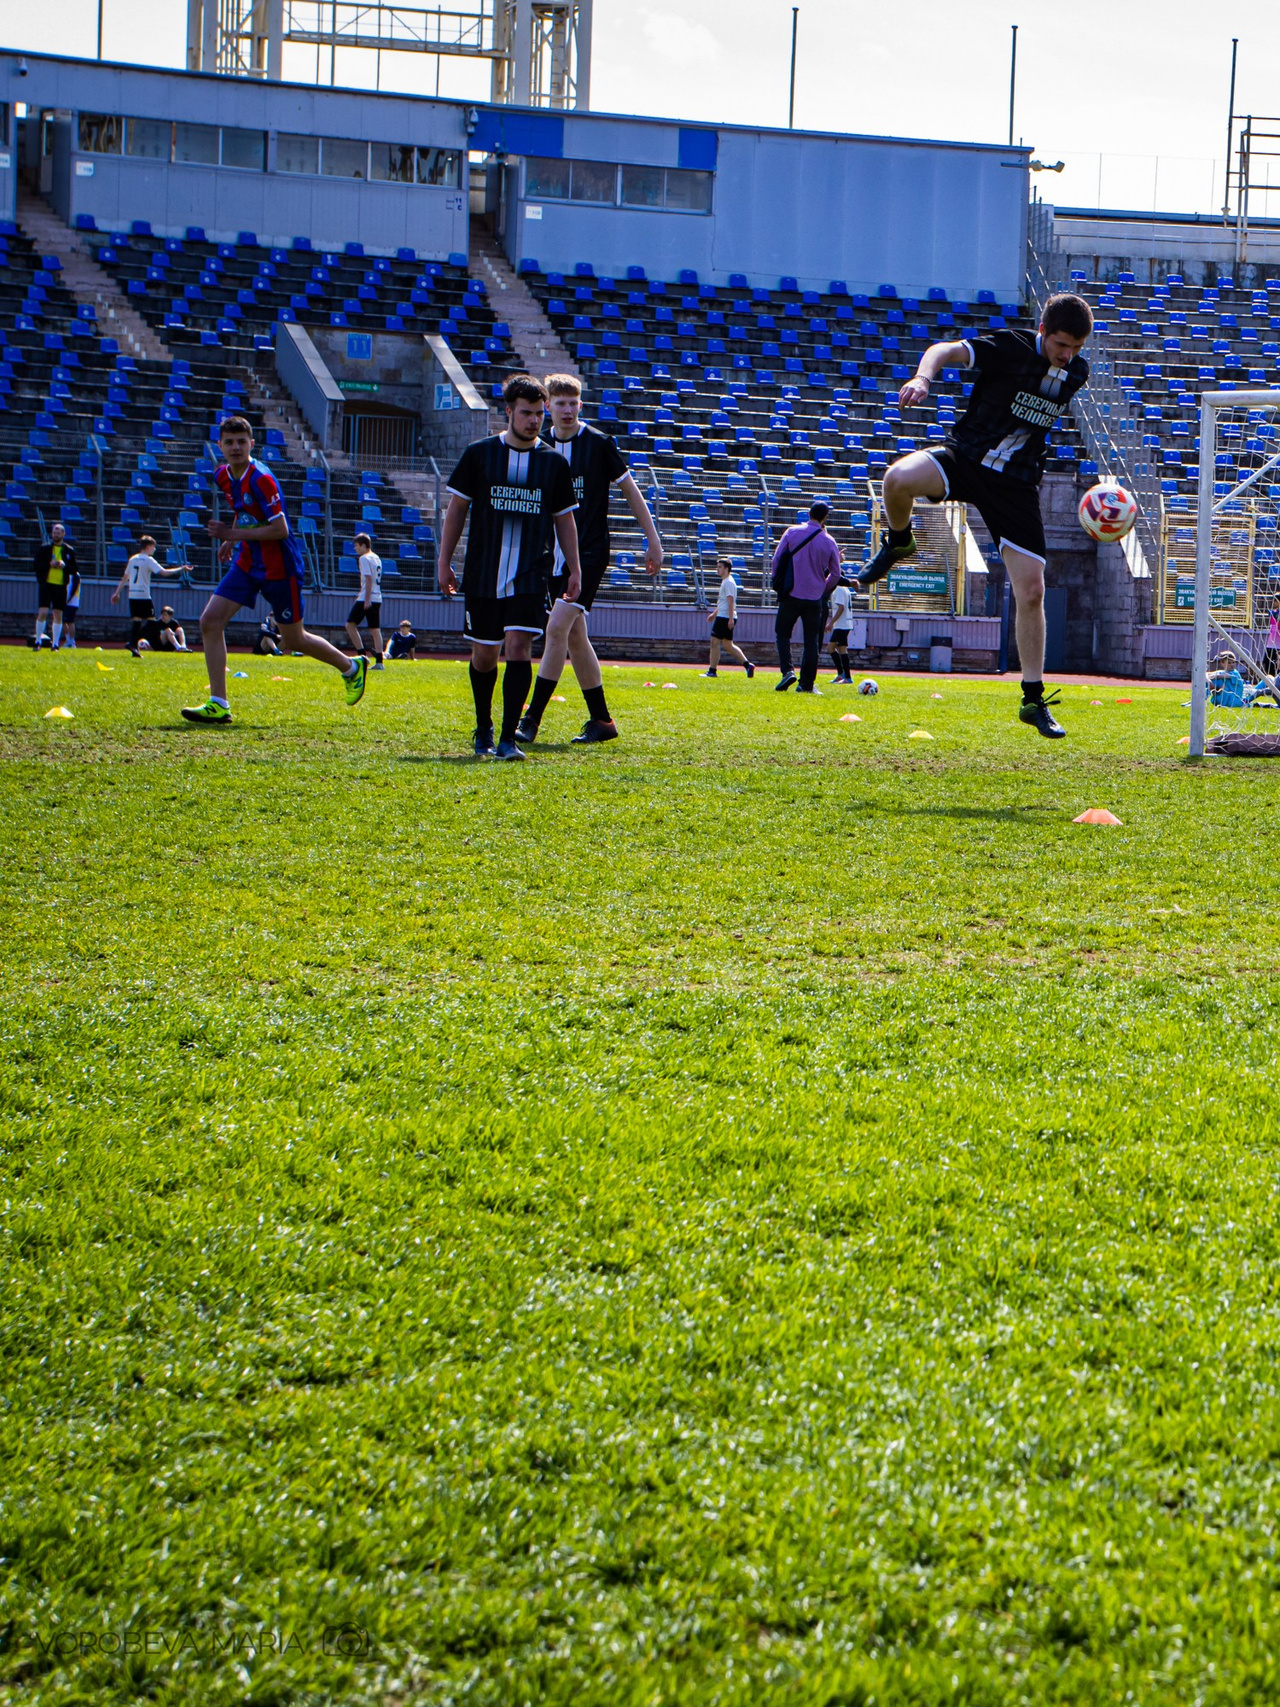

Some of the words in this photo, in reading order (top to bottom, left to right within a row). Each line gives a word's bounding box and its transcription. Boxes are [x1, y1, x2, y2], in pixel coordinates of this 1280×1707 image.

[353, 340, 367, 352] 11
[490, 485, 542, 502] СЕВЕРНЫЙ
[490, 498, 541, 514] ЧЕЛОВЕК
[133, 566, 139, 584] 7
[281, 608, 292, 619] 6
